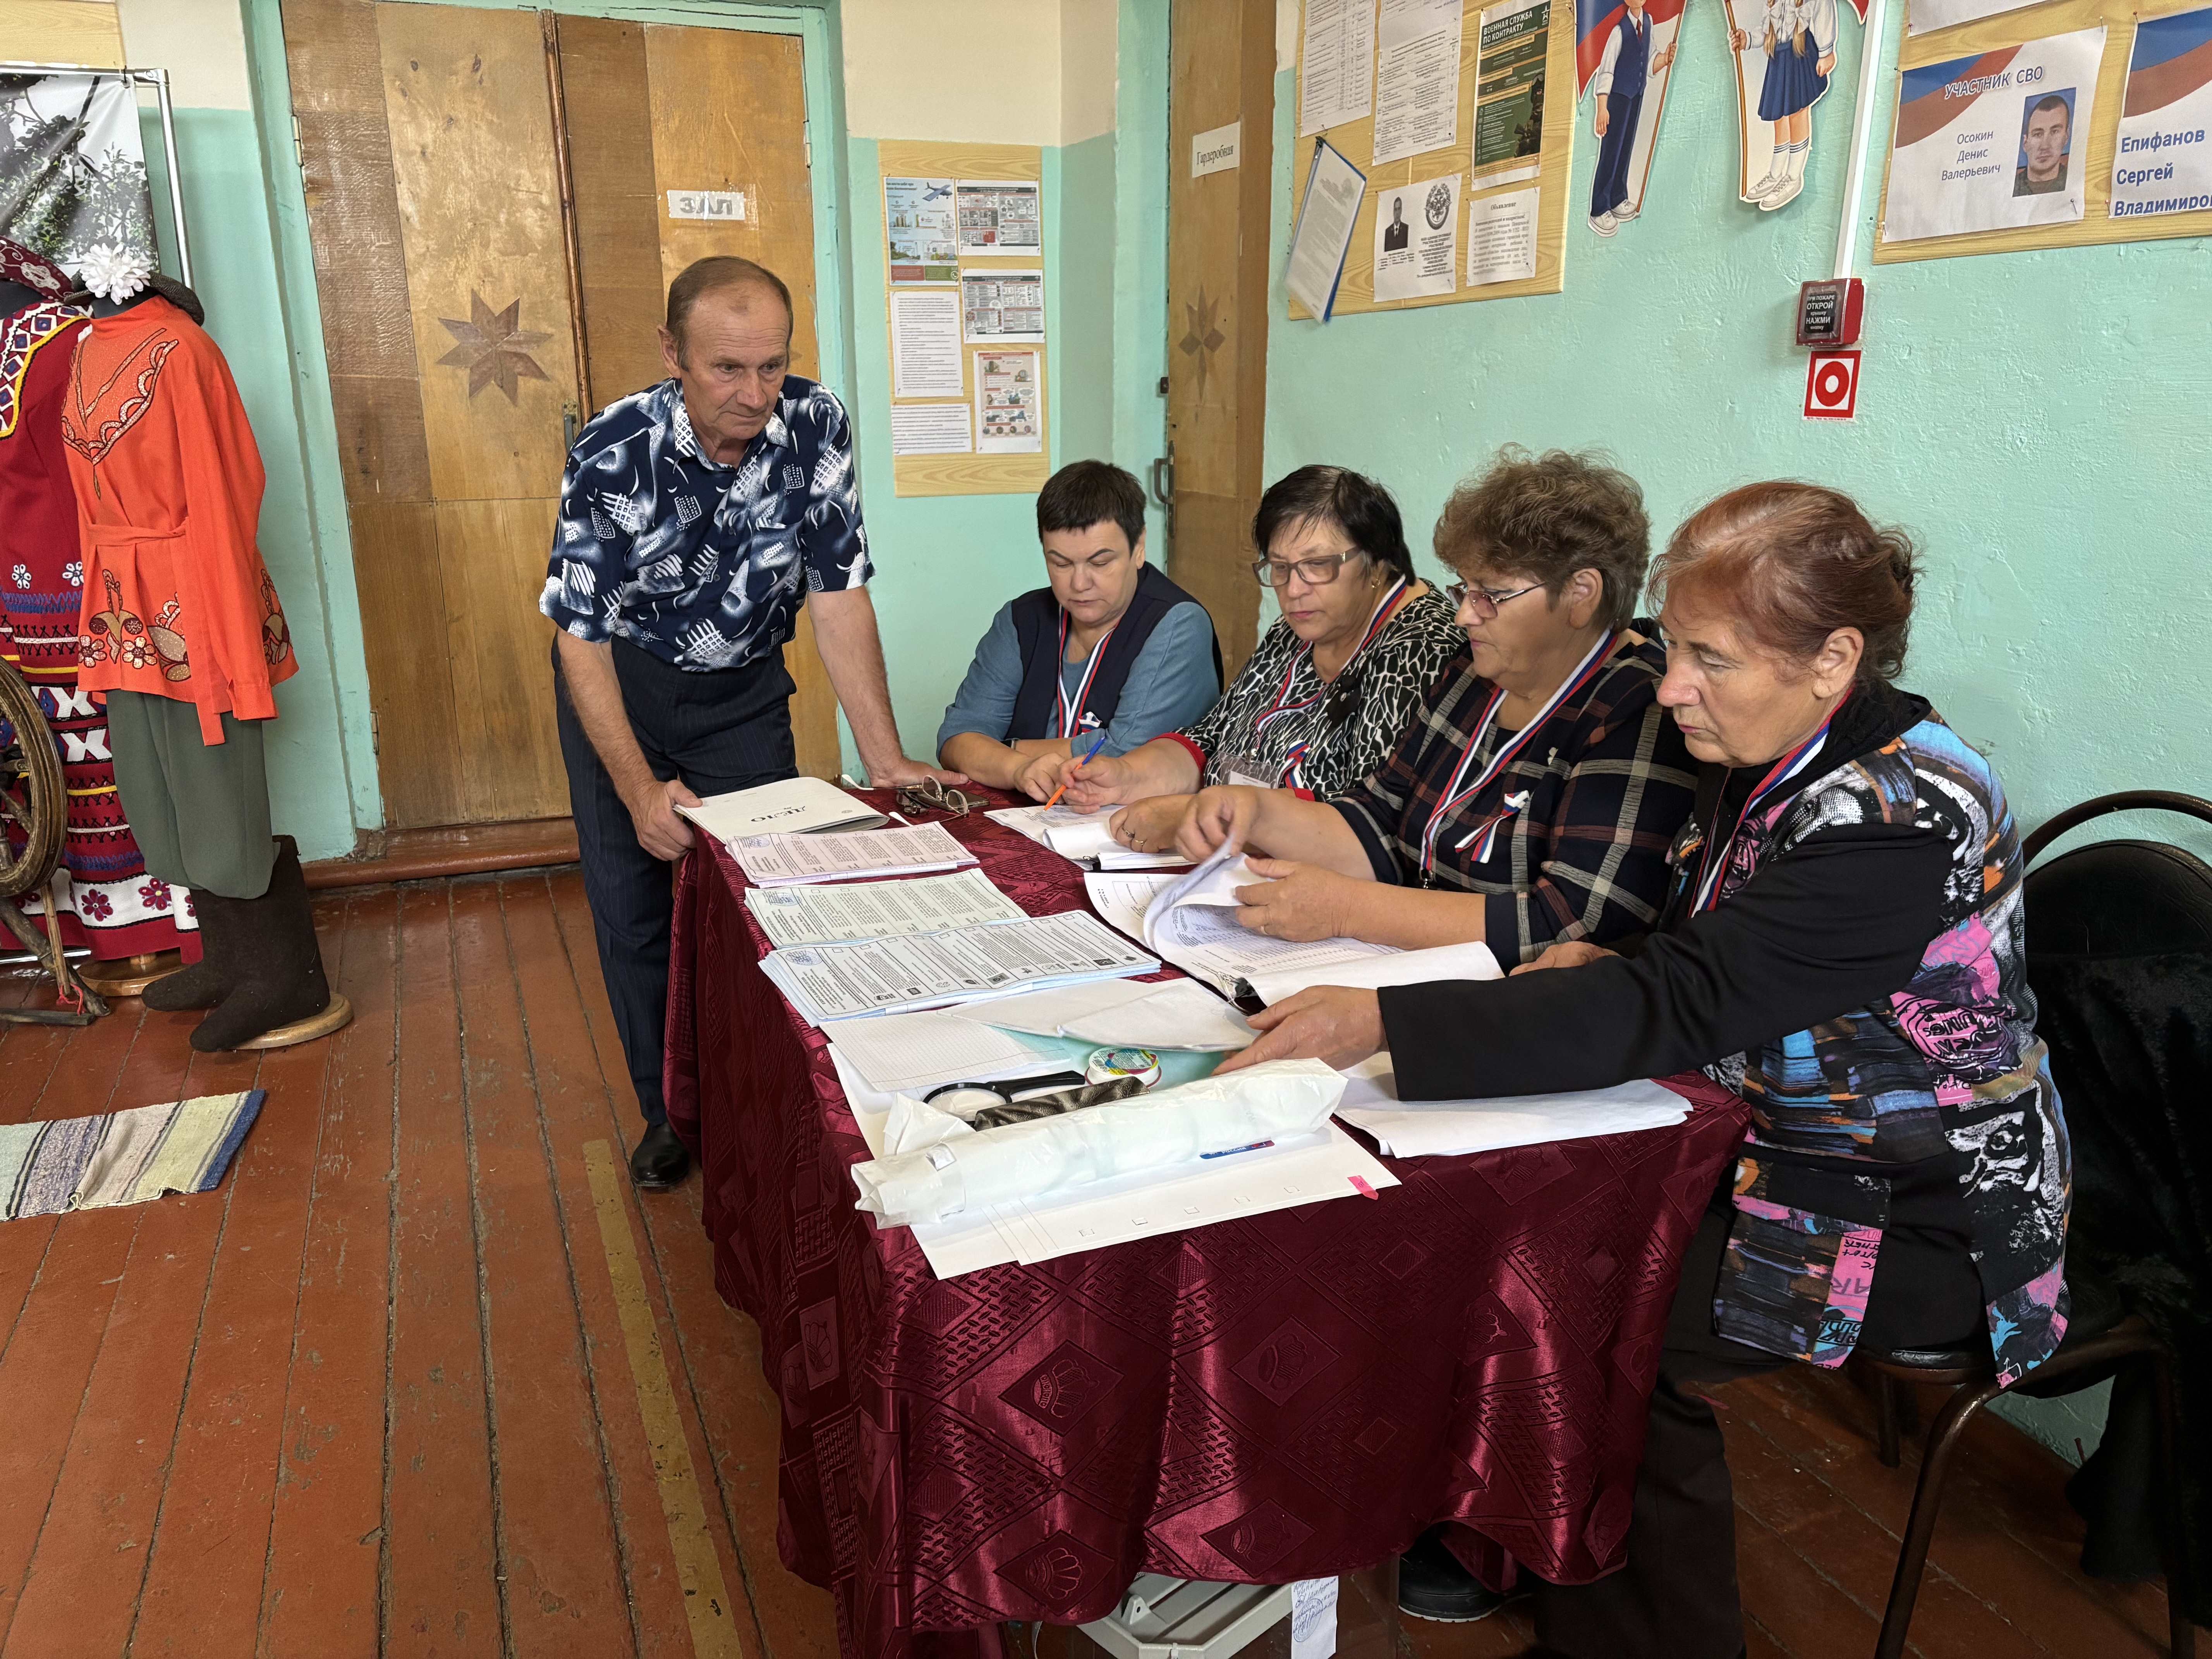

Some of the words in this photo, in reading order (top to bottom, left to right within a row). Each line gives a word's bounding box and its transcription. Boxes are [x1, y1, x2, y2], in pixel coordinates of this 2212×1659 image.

[1483, 35, 1491, 44] ПО
[1492, 22, 1524, 41] КОНТРАКТУ
[1484, 19, 1509, 35] ВОЕННАЯ
[1510, 10, 1532, 25] СЛУЖБА
[1945, 72, 2010, 99] УЧАСТНИК
[2016, 66, 2043, 83] СВО
[1957, 131, 1994, 144] Осокин
[2121, 130, 2205, 153] Епифанов
[1957, 149, 1988, 164] Денис
[1942, 165, 2001, 180] Валерьевич
[2117, 162, 2173, 187] Сергей
[2114, 195, 2212, 216] Владимиро
[1807, 301, 1833, 310] ОТКРОЙ
[751, 806, 806, 822] ДЕЛО
